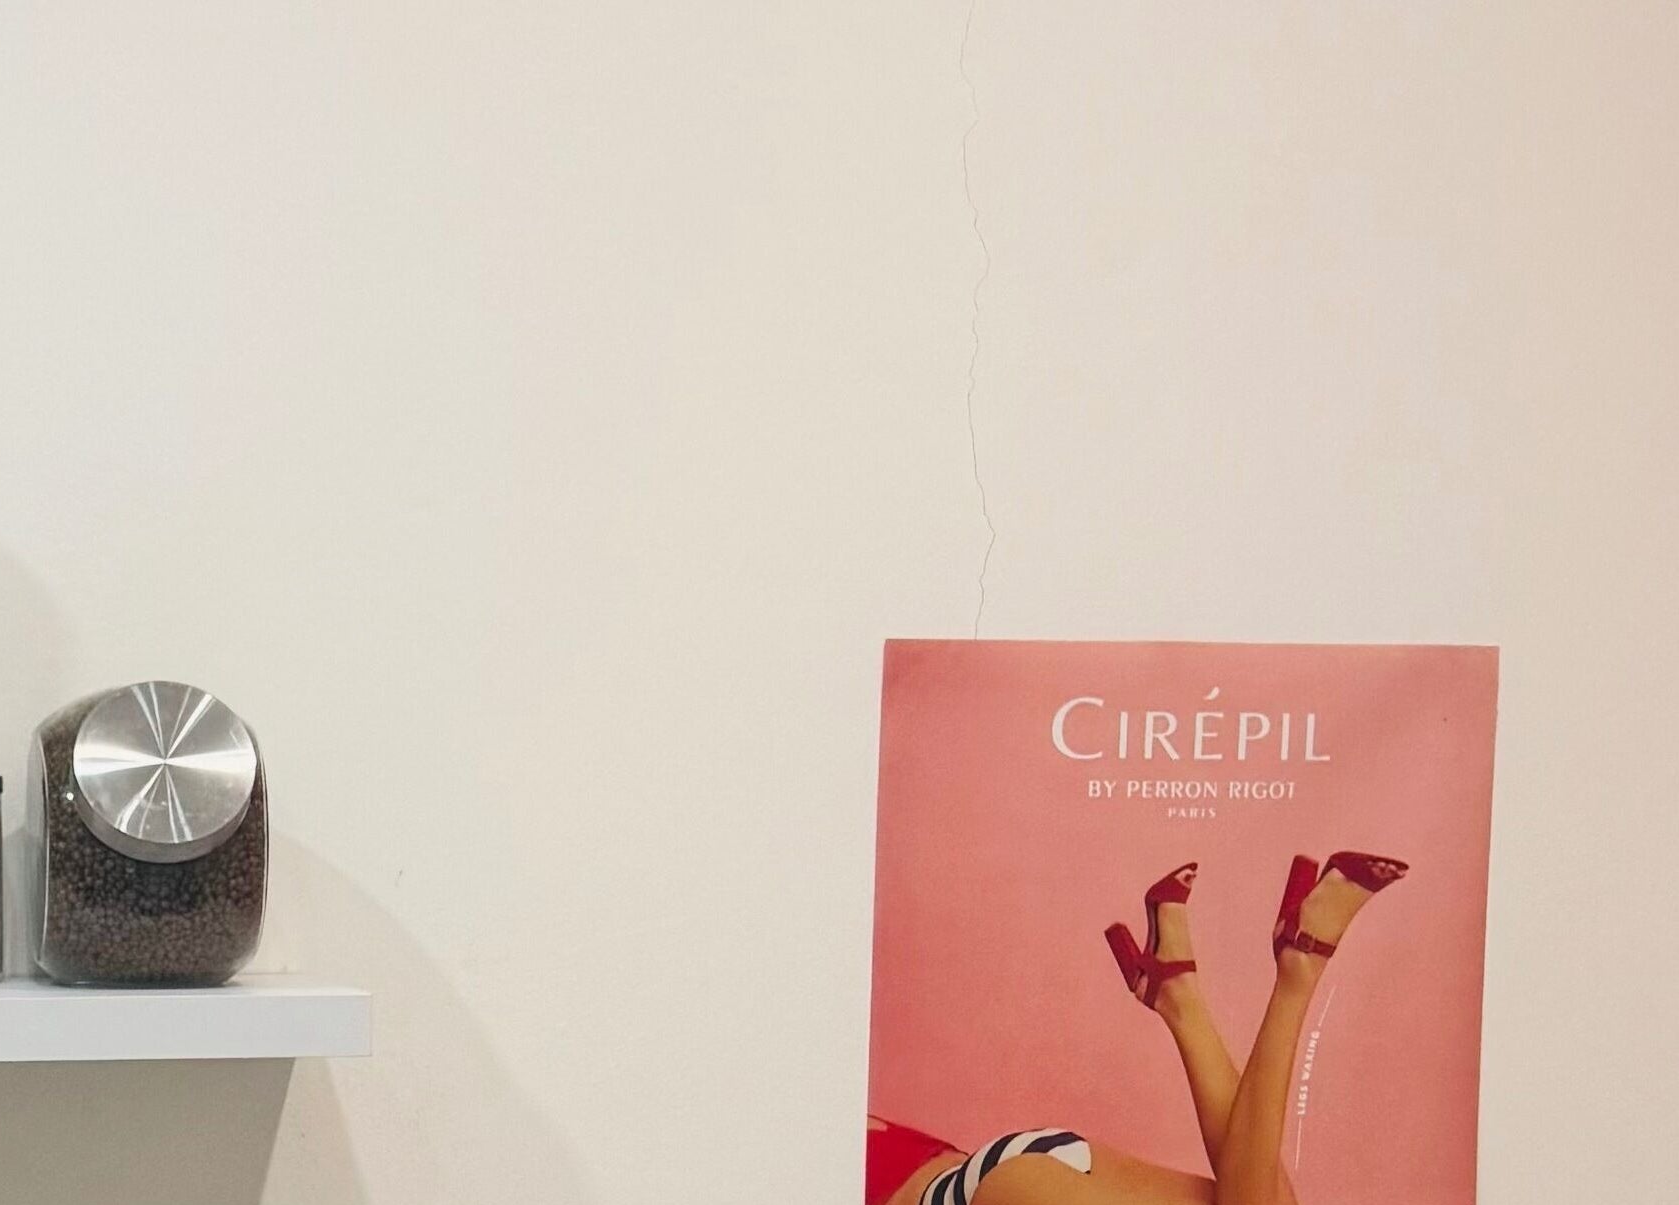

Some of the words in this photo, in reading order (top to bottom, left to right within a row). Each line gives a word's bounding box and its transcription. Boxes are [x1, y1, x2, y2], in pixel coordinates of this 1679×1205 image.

[1052, 687, 1331, 761] CIRÉPIL
[1088, 780, 1117, 798] BY
[1127, 780, 1218, 799] PERRON
[1228, 781, 1295, 800] RIGOT
[1168, 807, 1217, 819] PARIS
[1302, 1030, 1321, 1081] WAXING
[1297, 1085, 1309, 1115] LEGS
